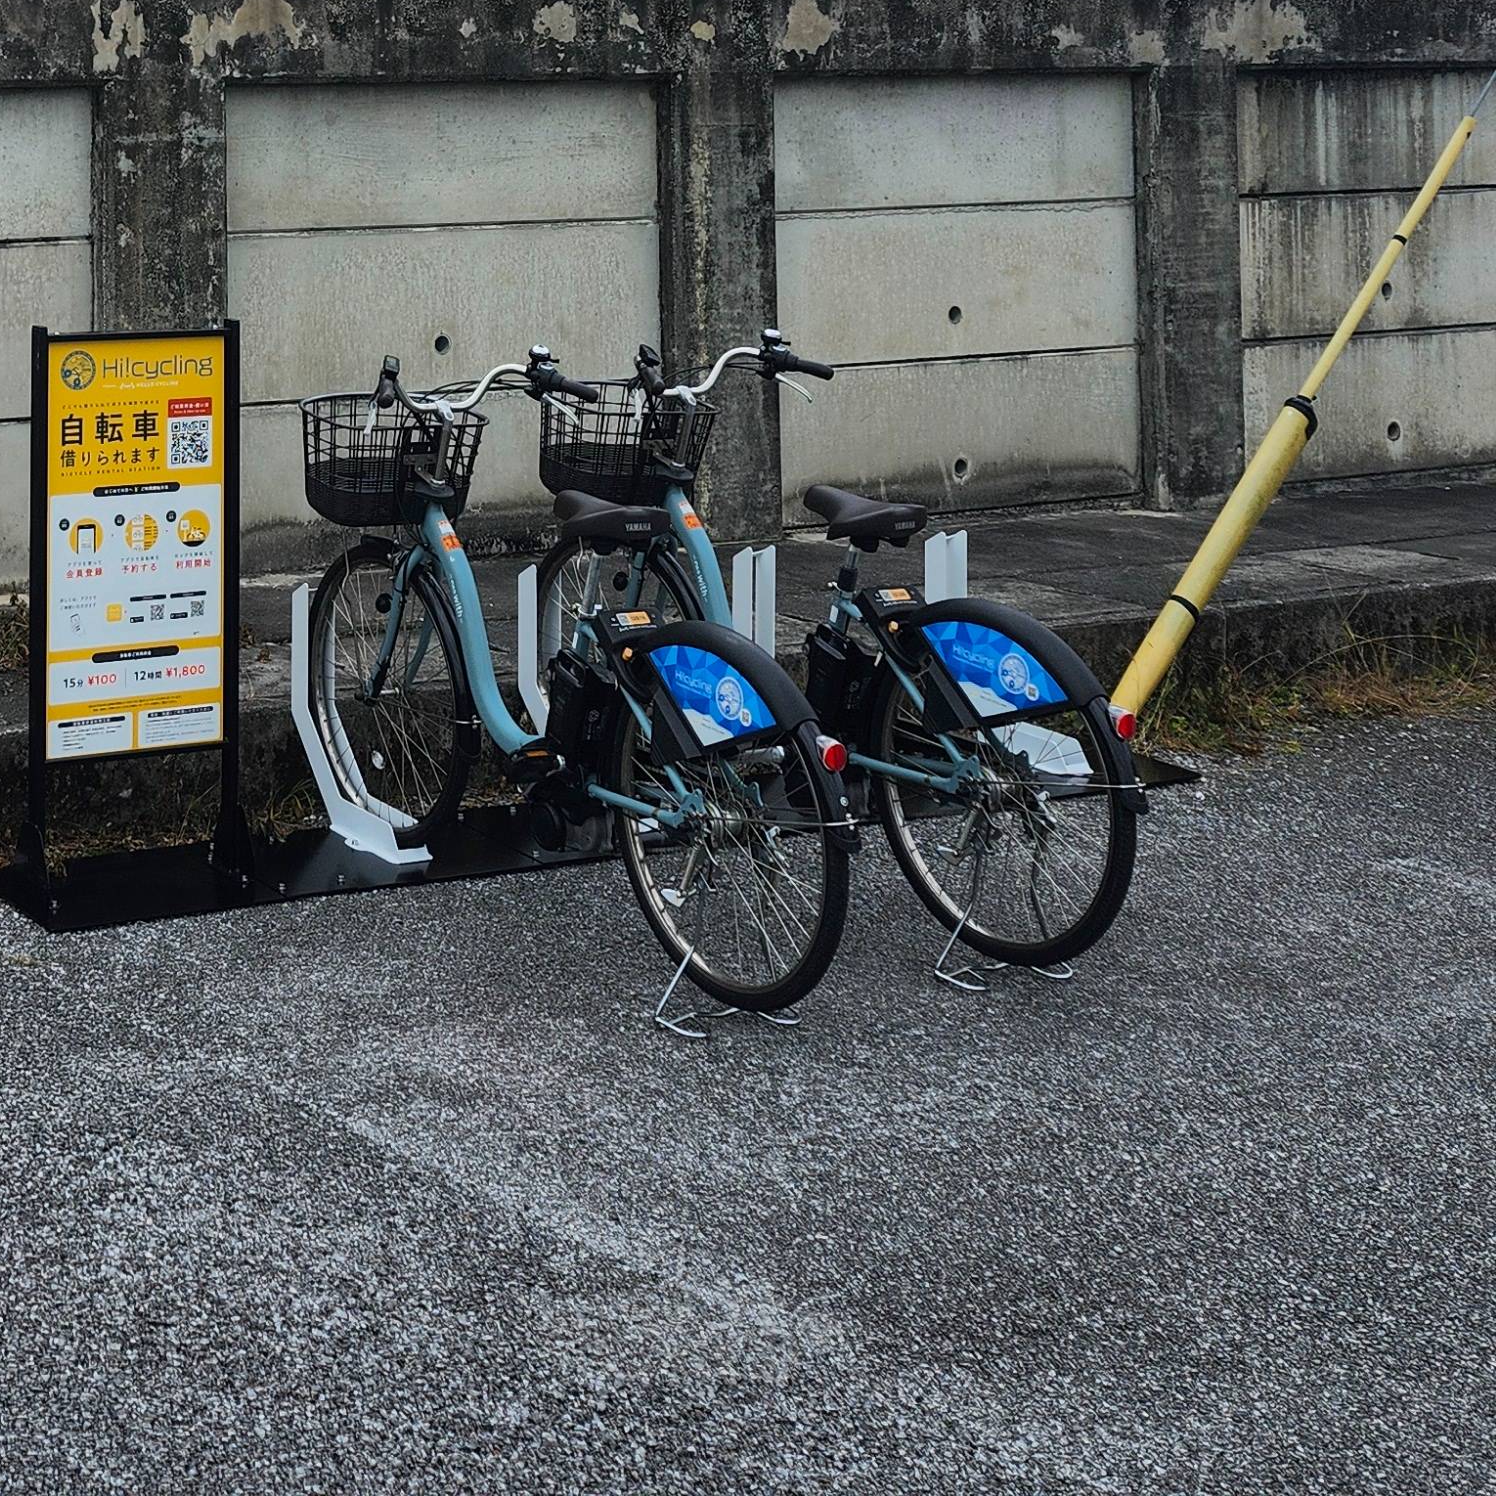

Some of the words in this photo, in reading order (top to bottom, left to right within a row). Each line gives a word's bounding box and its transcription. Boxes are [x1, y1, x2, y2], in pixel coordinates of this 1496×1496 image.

[101, 354, 213, 380] Hi!cycling
[60, 409, 160, 447] 自転車
[60, 446, 161, 469] 借りられます
[624, 522, 652, 532] YAMAHA
[121, 562, 158, 575] 予約する
[175, 557, 212, 570] 利用開始
[65, 567, 104, 580] 会員登録
[165, 663, 206, 679] ¥1,800
[63, 677, 84, 689] 15分
[87, 673, 117, 686] ¥100
